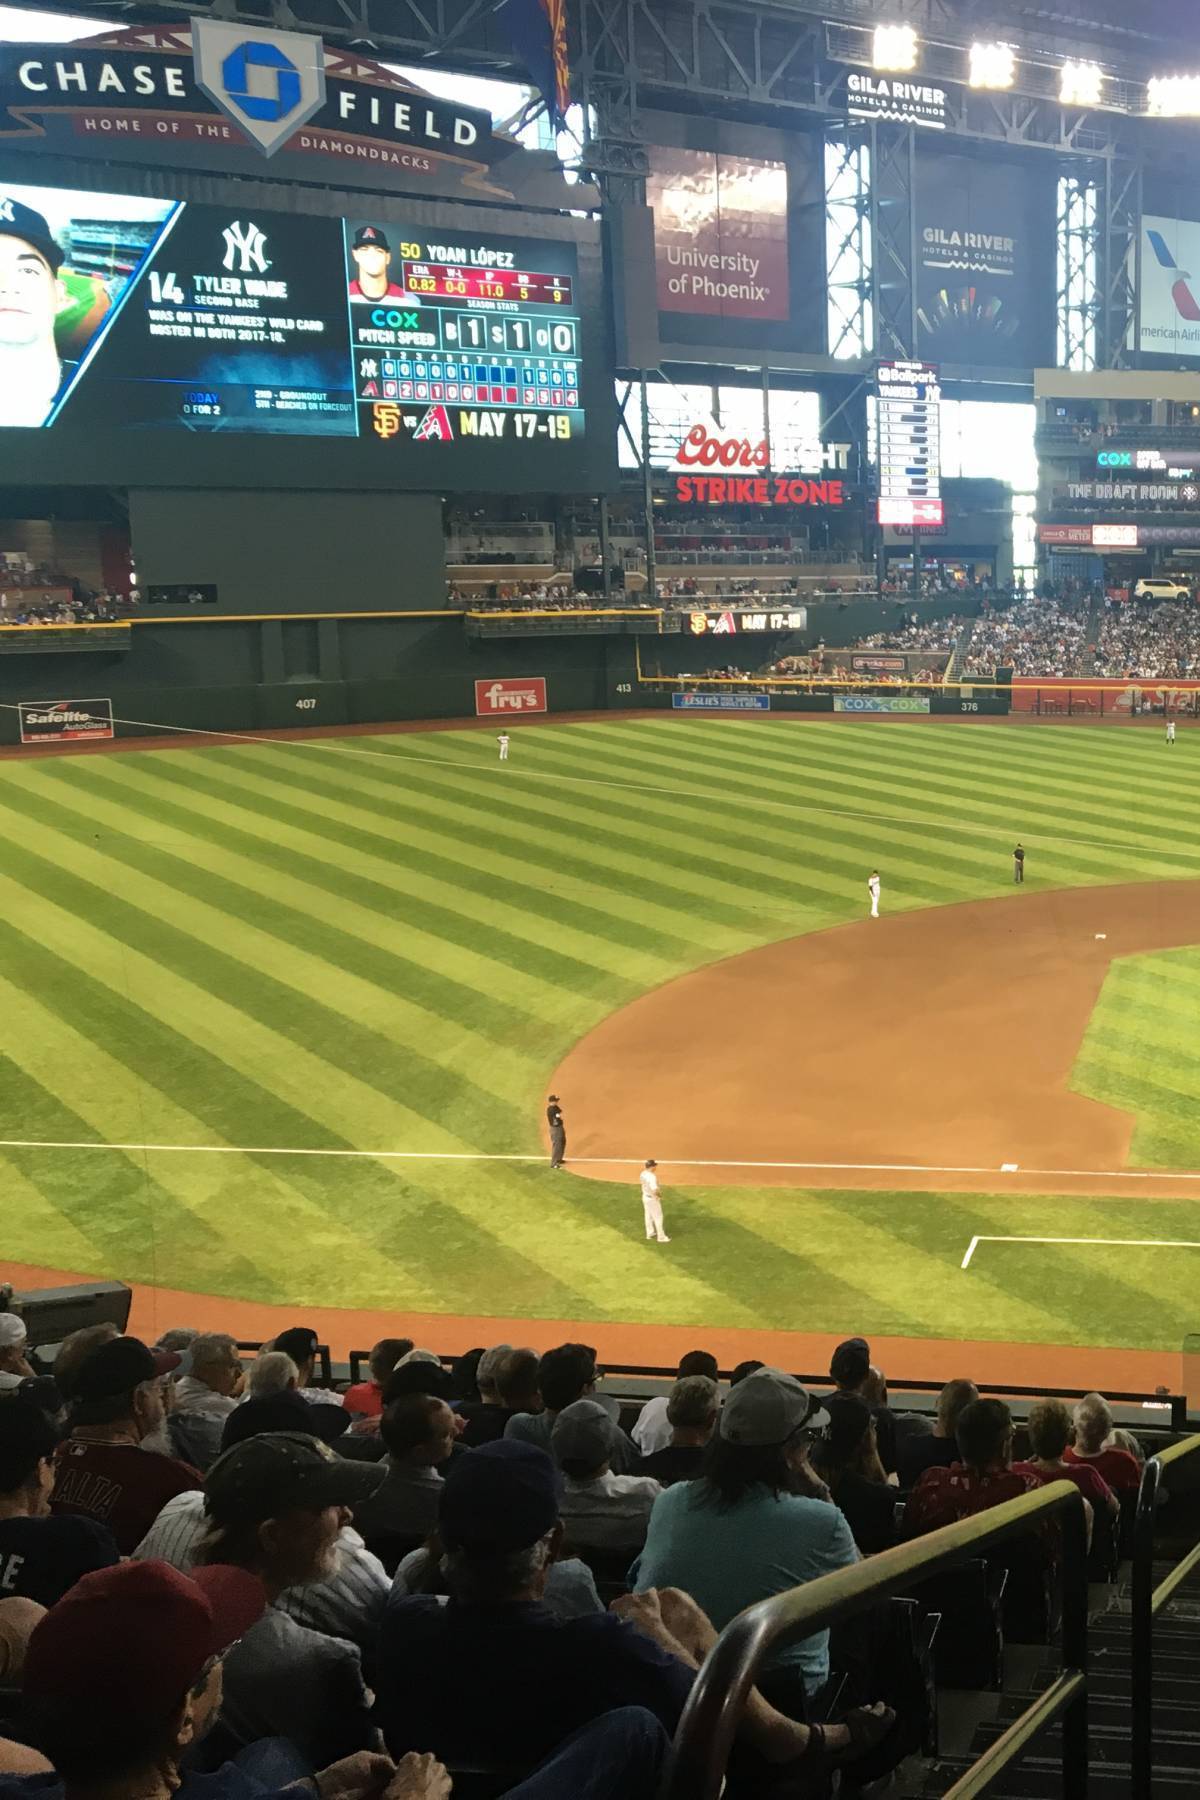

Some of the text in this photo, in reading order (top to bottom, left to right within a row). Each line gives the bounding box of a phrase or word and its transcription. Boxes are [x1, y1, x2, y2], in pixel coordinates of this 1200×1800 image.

[848, 74, 944, 105] GILA RIVER
[18, 60, 478, 146] CHASE FIELD
[848, 94, 944, 116] HOTELS CASINOS
[85, 118, 431, 170] HOME OF THE DIAMONDBACKS
[923, 227, 1013, 252] GILA RIVER
[400, 242, 514, 268] 50 YOAN LÓPEZ
[668, 246, 759, 278] University
[923, 247, 1014, 263] HOTELS CASINOS
[412, 265, 429, 274] ERA
[149, 271, 184, 304] 14
[193, 275, 241, 295] TYLER
[408, 278, 561, 302] 0.82 0-0 11.0 5 9
[669, 274, 688, 293] of
[194, 295, 260, 308] SECOND BASE
[467, 299, 519, 311] SEASON STATS
[194, 312, 215, 324] THE
[269, 318, 294, 330] WILD
[370, 309, 419, 329] COX
[445, 322, 457, 340] B
[467, 319, 479, 345] 1
[492, 326, 503, 343] S
[512, 322, 523, 348] 1
[553, 325, 571, 351] 0
[358, 328, 436, 346] PITCH SPEED
[1141, 326, 1180, 339] merican
[891, 369, 937, 385] Ballpark
[184, 393, 218, 403] TODAY
[879, 385, 918, 398] YANKEES
[193, 403, 352, 414] FOR 2 FORCEOUT
[460, 411, 506, 437] MAY
[514, 413, 570, 438] 17-19
[676, 424, 770, 467] Coors
[1098, 452, 1131, 465] COX
[676, 477, 842, 504] STRIKE ZONE
[1068, 484, 1091, 498] THE
[1096, 484, 1137, 499] DRAFT
[742, 614, 767, 629] MAY
[484, 683, 537, 709] fry's
[616, 684, 631, 692] 413
[296, 699, 316, 709] 407
[845, 700, 918, 710] COX COX
[26, 711, 89, 724] Safelite
[63, 722, 108, 730] AutoGlass
[54, 1468, 123, 1520] ALTA
[0, 1553, 25, 1590] E
